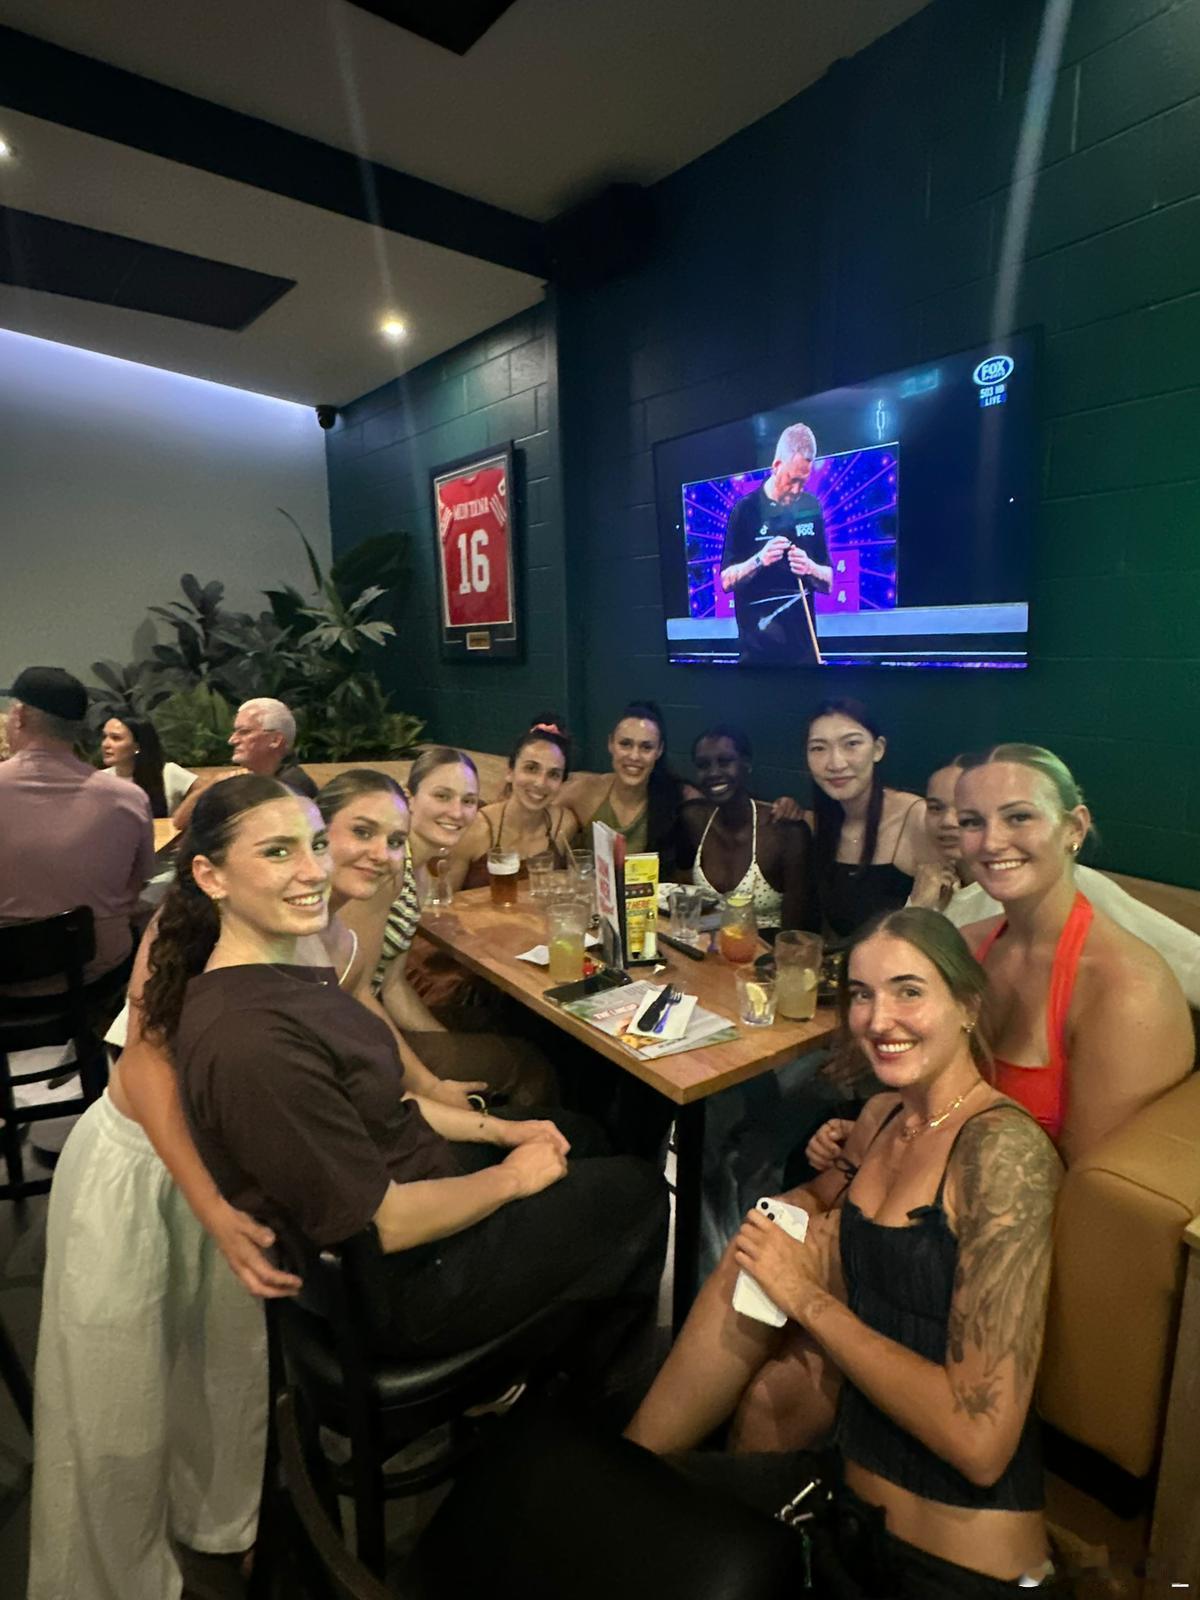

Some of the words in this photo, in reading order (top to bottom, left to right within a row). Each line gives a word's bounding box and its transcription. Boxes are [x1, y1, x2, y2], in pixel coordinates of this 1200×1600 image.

[981, 359, 1006, 377] FOX
[984, 394, 1002, 407] LIVE
[457, 528, 491, 595] 16
